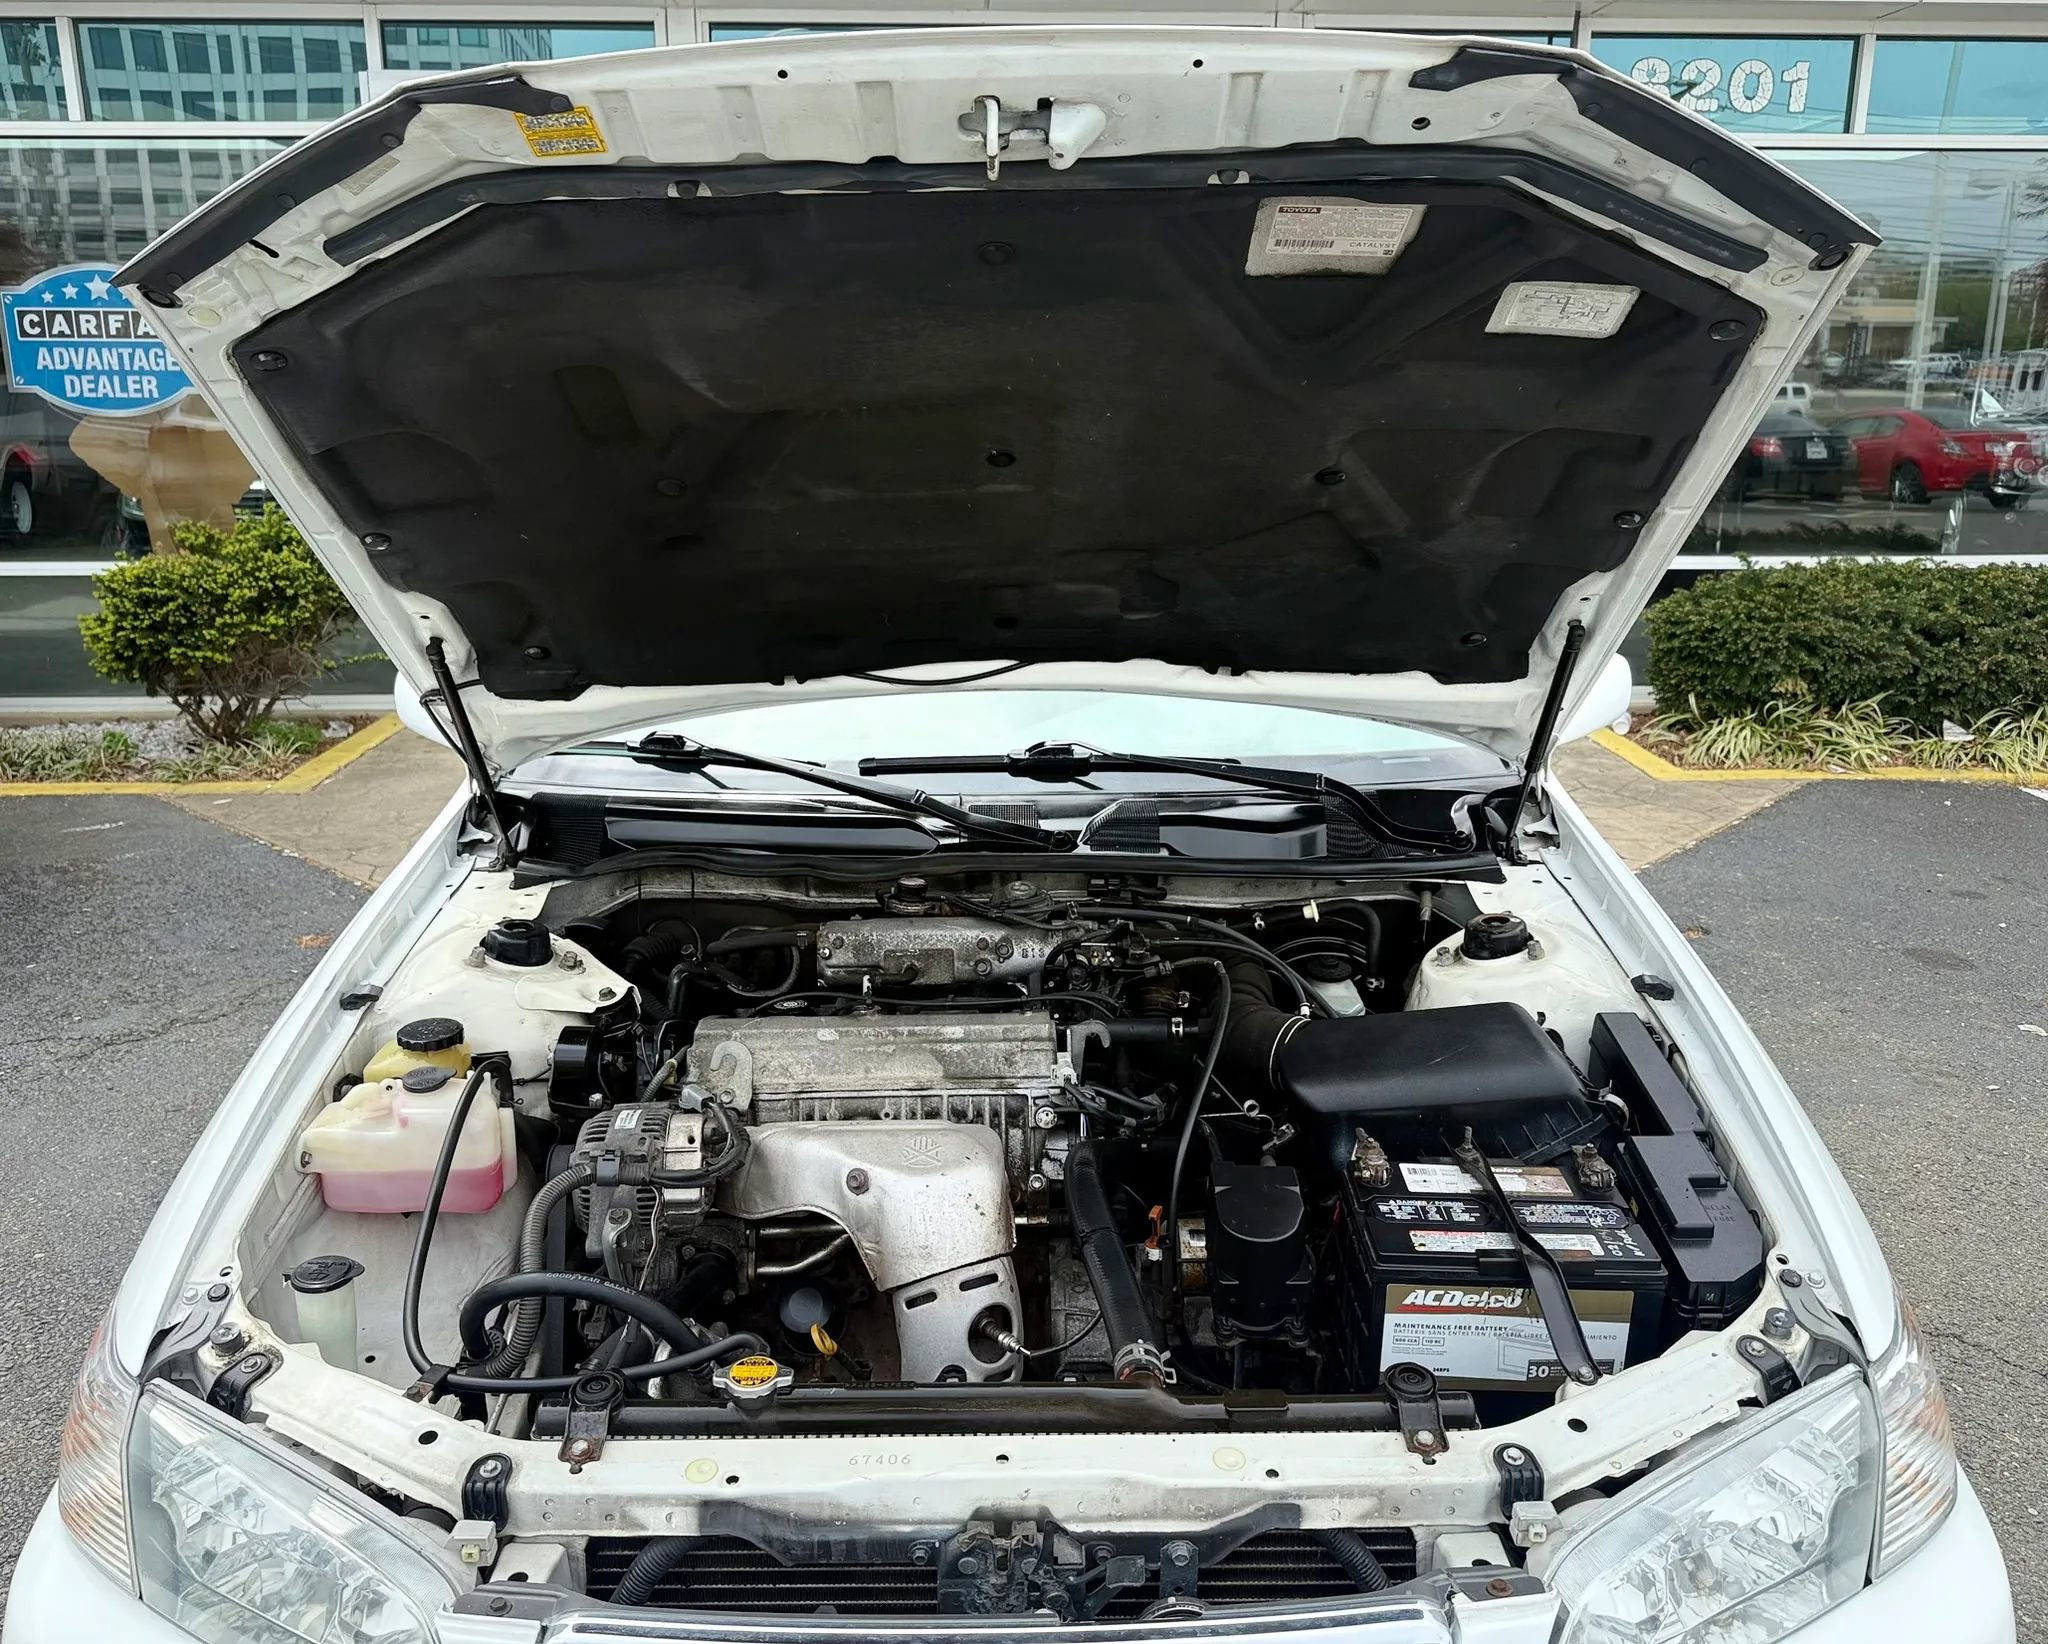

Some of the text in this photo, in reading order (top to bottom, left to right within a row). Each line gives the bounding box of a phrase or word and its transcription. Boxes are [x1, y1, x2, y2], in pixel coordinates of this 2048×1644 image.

[1349, 240, 1397, 249] CATALYST
[22, 313, 158, 336] CARFA
[37, 347, 182, 372] ADVANTAGE
[64, 374, 160, 399] DEALER
[545, 1271, 601, 1285] GOODYEAR
[1401, 1288, 1524, 1309] ACDelco
[1393, 1322, 1452, 1331] MAINTENANCE
[1453, 1324, 1472, 1332] FREE
[1528, 1365, 1550, 1378] 30
[848, 1454, 911, 1466] 67406
